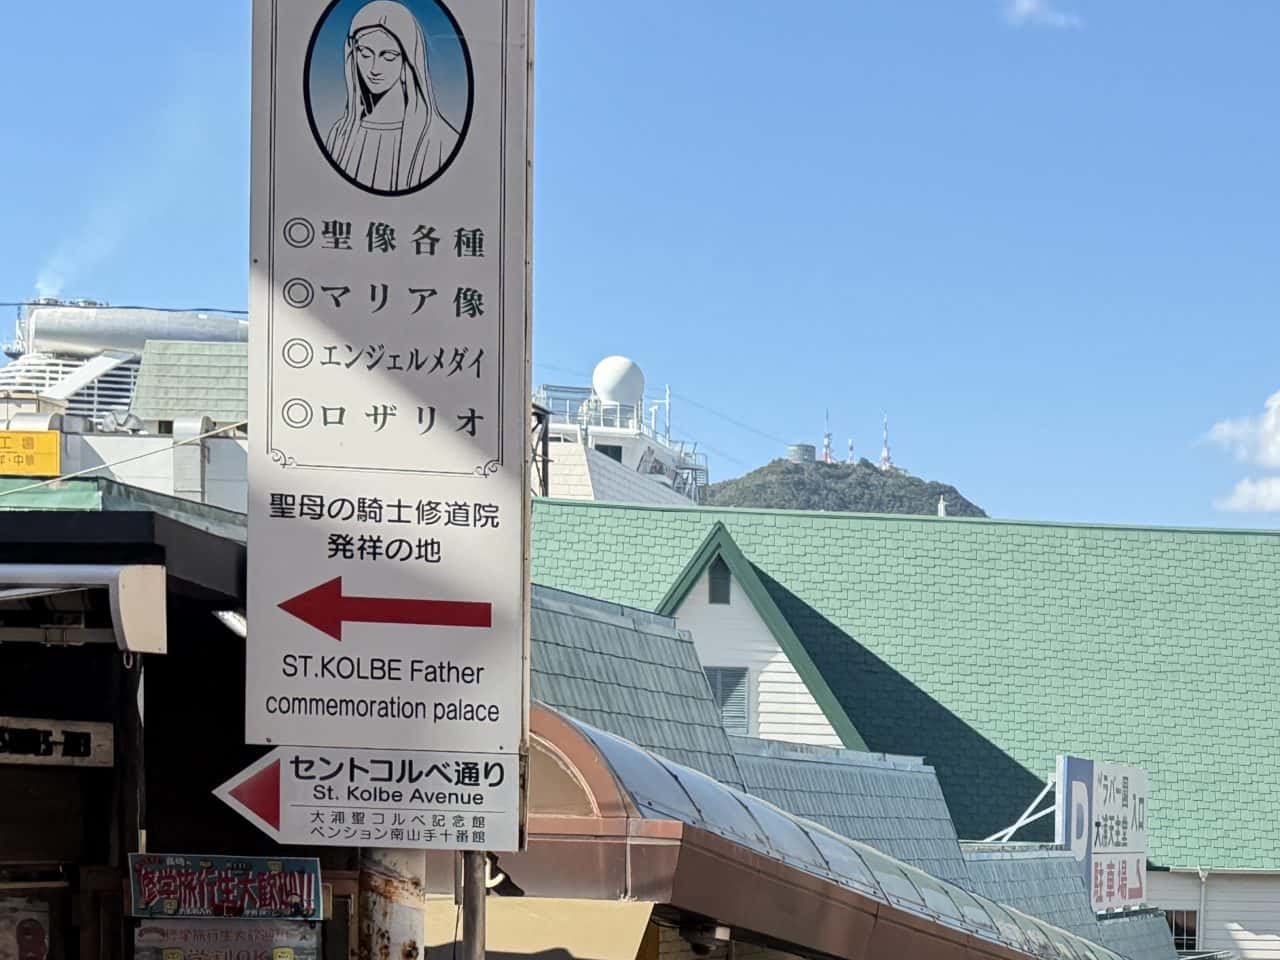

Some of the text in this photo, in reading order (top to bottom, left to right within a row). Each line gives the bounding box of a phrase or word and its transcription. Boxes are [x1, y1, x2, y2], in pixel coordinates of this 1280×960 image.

[321, 219, 486, 258] 聖像各種
[320, 283, 485, 318] マリア像
[320, 343, 484, 379] エンジェルメダイ
[320, 404, 485, 437] ロザリオ
[269, 492, 500, 529] 聖母の騎士修道院
[327, 532, 441, 563] 発祥の地
[281, 653, 484, 684] ST.KOLBE Father
[265, 696, 500, 723] commemoration palace
[289, 754, 505, 788] セントコルベ通り
[312, 784, 484, 806] St. Kolbe Avenue
[310, 811, 486, 829] 大浦聖コルベ記念館
[310, 827, 486, 844] ペンション南山手十番館
[1093, 859, 1128, 903] 駐車場
